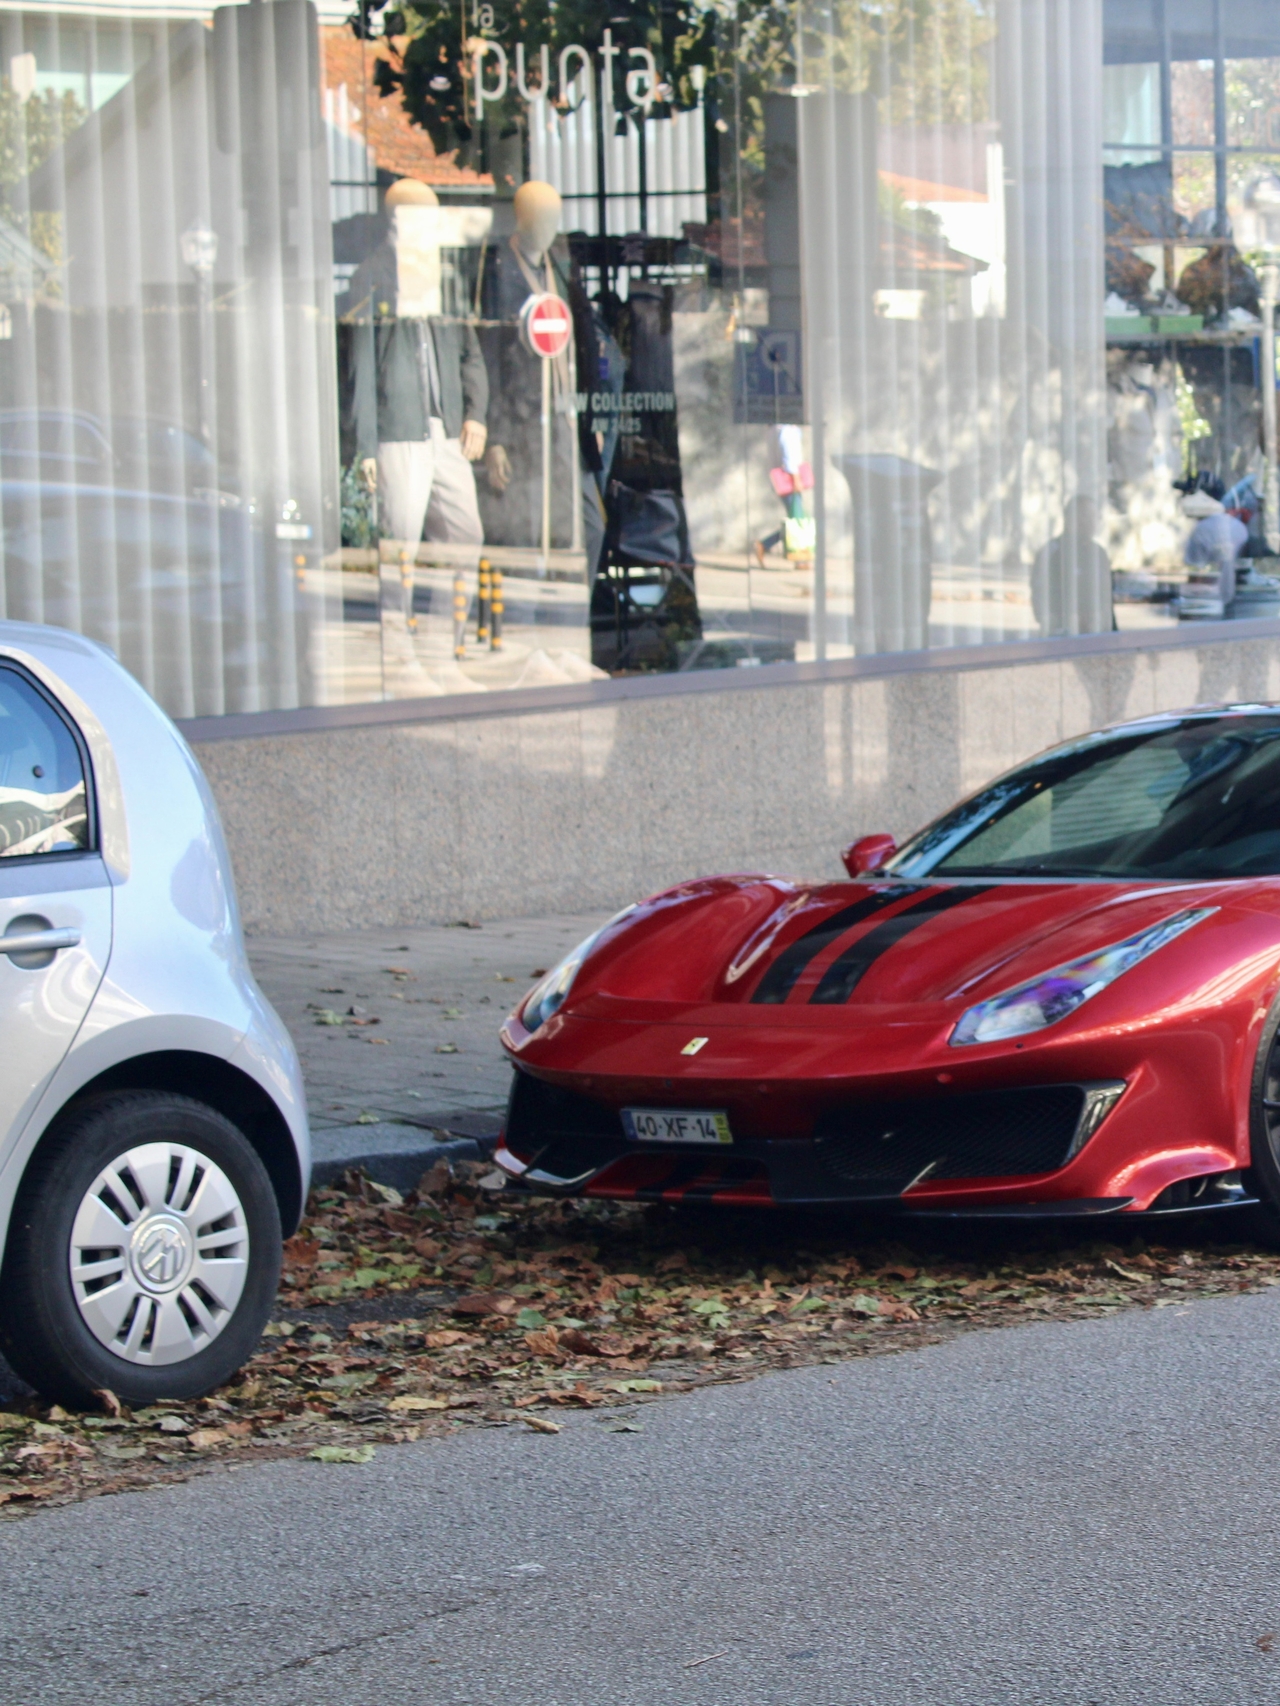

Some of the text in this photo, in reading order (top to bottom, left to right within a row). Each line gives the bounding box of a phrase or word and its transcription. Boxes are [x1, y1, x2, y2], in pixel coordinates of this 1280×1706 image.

[472, 0, 494, 28] la
[472, 28, 656, 121] punta
[591, 392, 674, 412] COLLECTION
